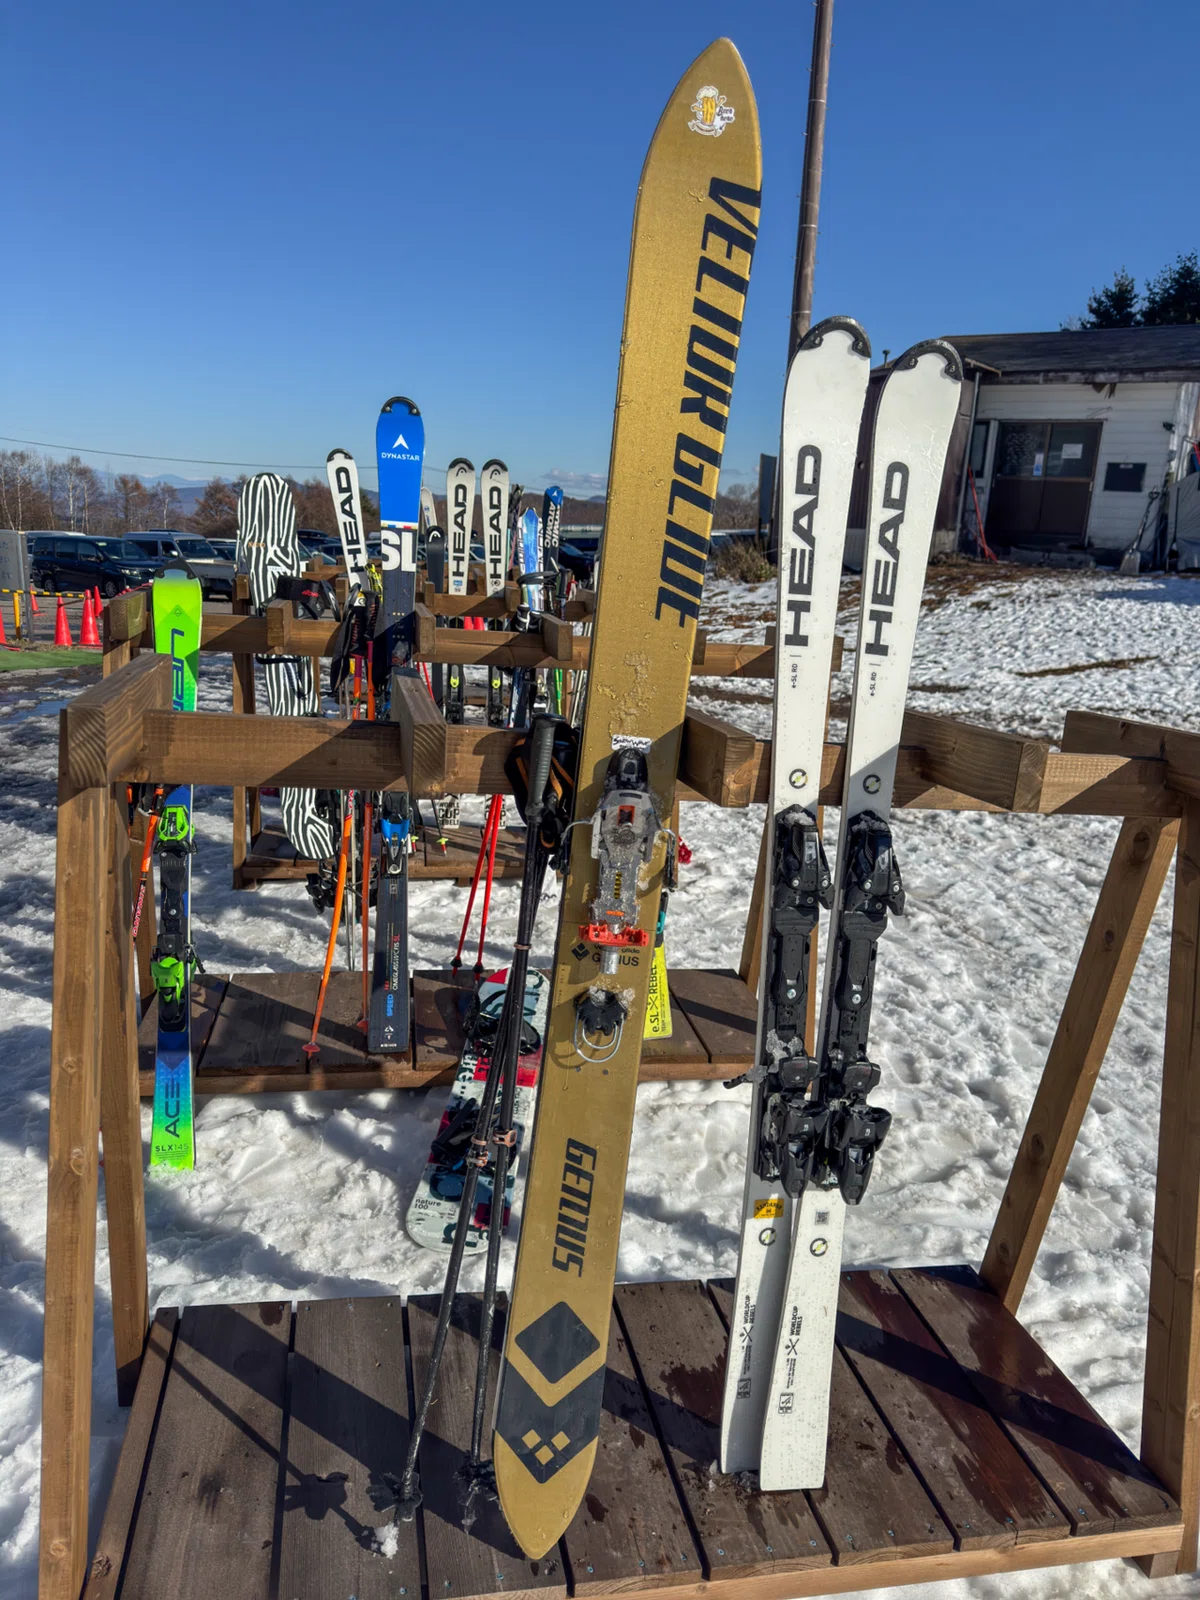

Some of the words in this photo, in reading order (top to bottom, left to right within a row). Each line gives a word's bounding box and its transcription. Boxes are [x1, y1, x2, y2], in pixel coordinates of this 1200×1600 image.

[381, 452, 420, 460] DYNASTAR
[335, 466, 365, 573] HEAD
[452, 483, 467, 577] HEAD
[489, 486, 502, 579] HEAD
[544, 501, 556, 548] ATOMIC
[381, 529, 417, 572] SL
[784, 444, 822, 647] HEAD
[865, 460, 910, 657] HEAD
[438, 808, 460, 819] CUP
[592, 952, 640, 967] GIUS
[386, 993, 394, 1017] SPEED
[165, 1078, 180, 1139] ACE
[415, 1198, 442, 1207] nature
[552, 1137, 598, 1278] GENIUS
[743, 1295, 751, 1325] WORLDCUP
[790, 1306, 798, 1336] WORLDCUP
